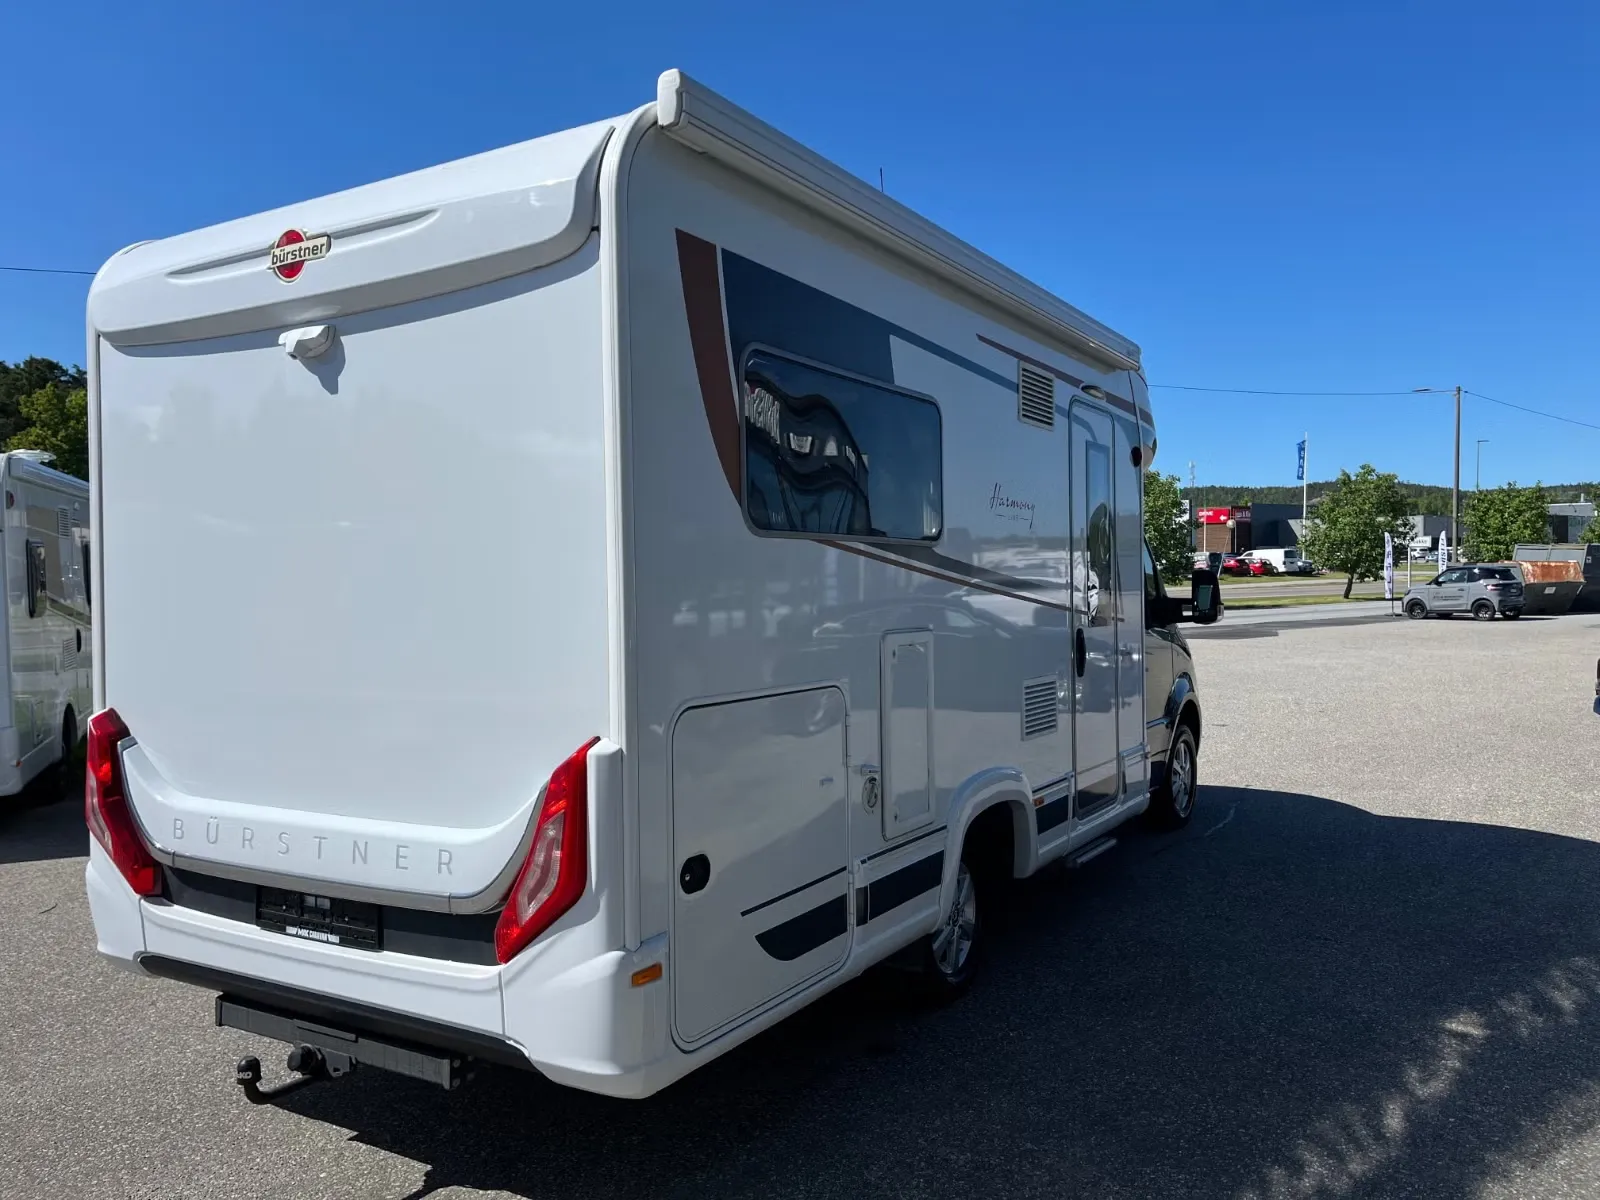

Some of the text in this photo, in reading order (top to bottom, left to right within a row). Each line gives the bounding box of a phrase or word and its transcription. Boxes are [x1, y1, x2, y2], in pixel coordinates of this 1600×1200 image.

[271, 243, 325, 266] bürstner
[990, 482, 1035, 530] Harmony
[172, 815, 454, 875] BÜRSTNER
